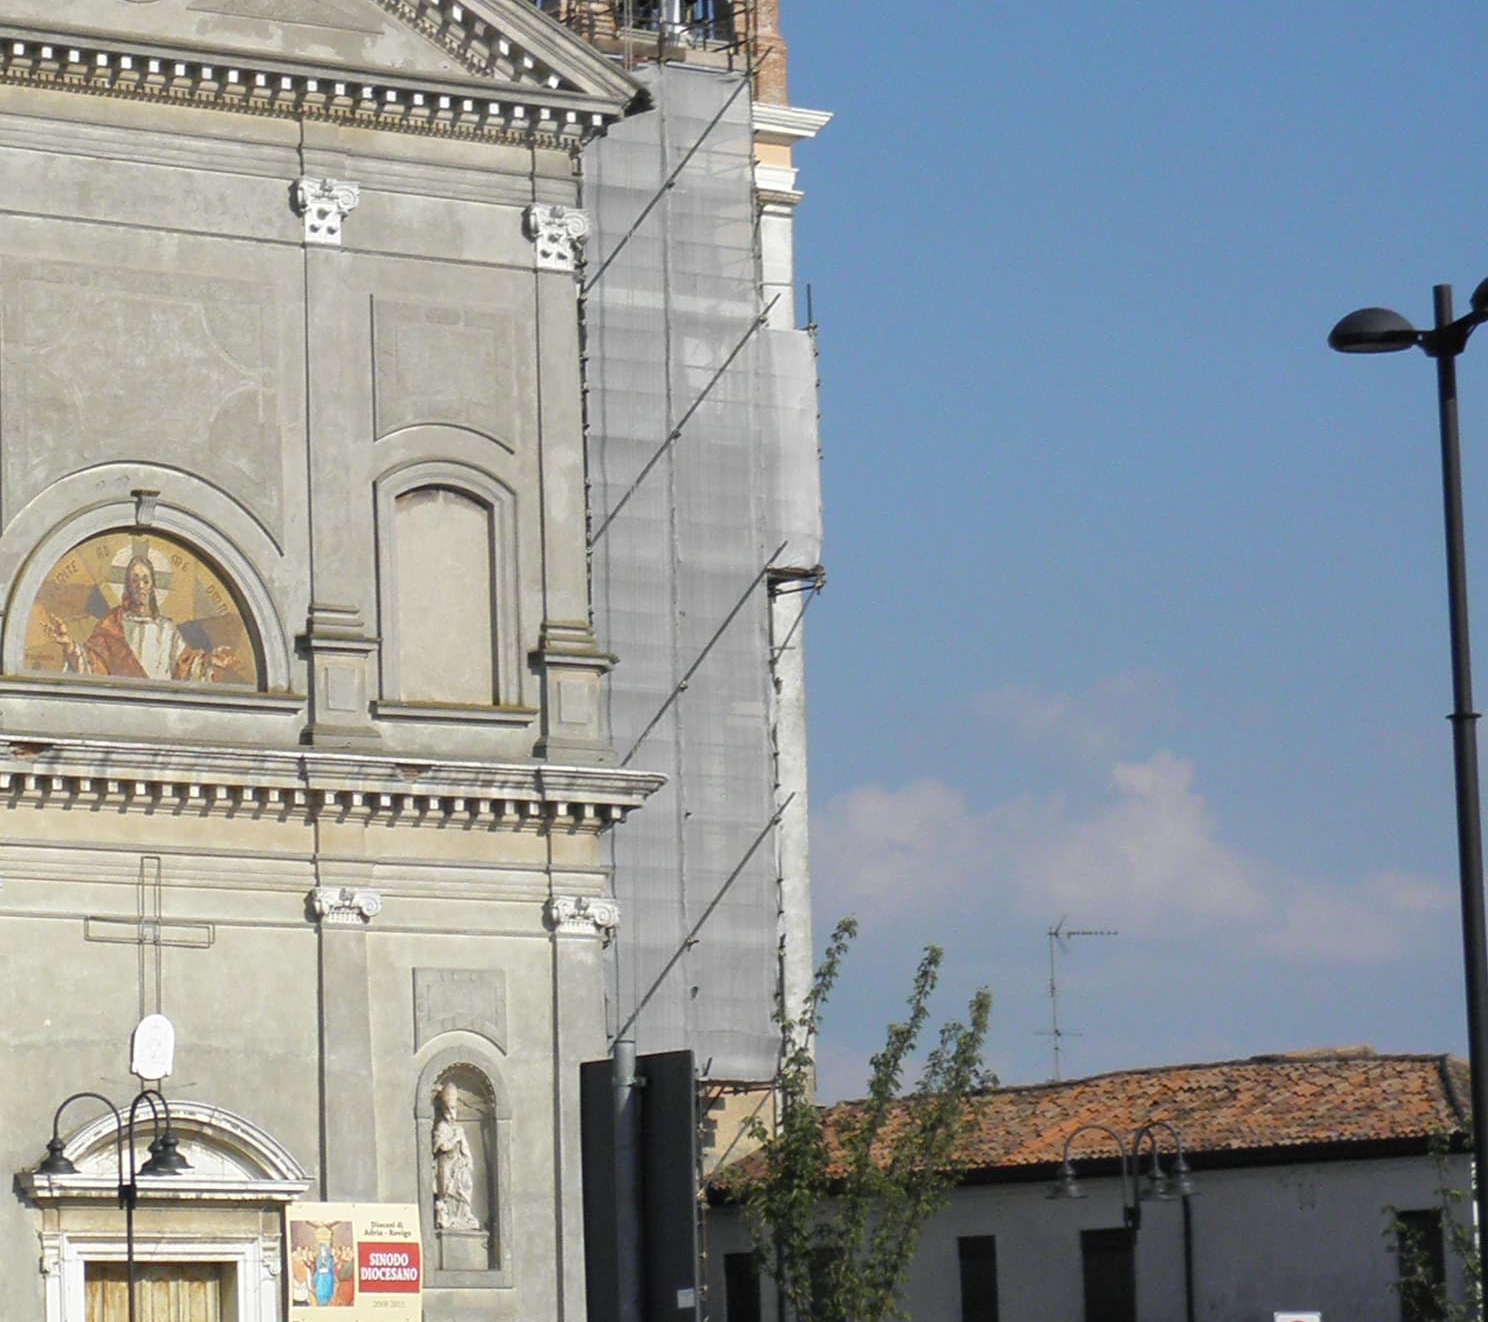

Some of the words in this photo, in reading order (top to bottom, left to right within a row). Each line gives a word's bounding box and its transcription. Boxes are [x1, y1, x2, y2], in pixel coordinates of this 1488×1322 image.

[364, 1229, 383, 1237] Adria
[389, 1229, 412, 1239] Rovigo
[369, 1252, 409, 1267] SINODO
[360, 1267, 418, 1281] DIOCESANO
